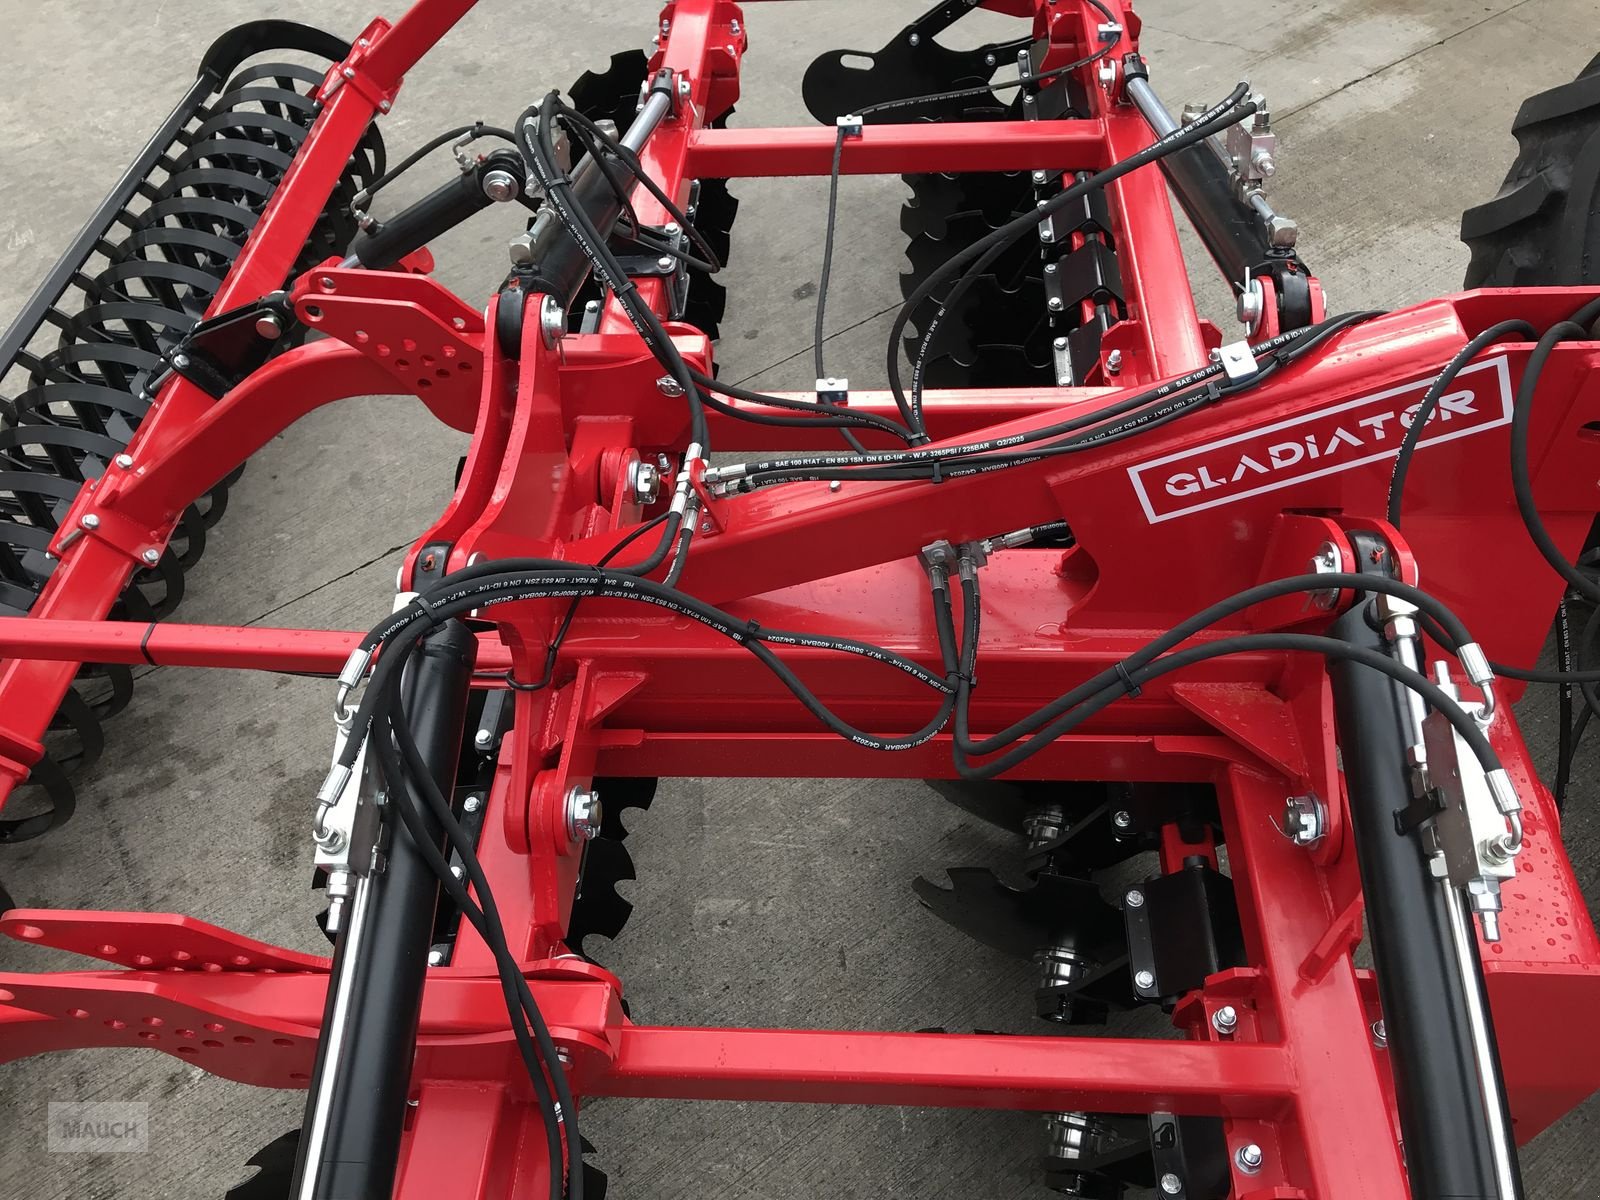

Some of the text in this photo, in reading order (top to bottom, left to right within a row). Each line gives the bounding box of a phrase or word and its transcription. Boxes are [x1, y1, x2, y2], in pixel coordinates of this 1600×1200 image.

[619, 296, 628, 309] R2A
[928, 320, 938, 332] SAE
[920, 342, 928, 357] R2AT
[1257, 342, 1272, 354] 1SN
[1274, 335, 1285, 345] DN
[916, 360, 922, 369] EN
[1158, 386, 1169, 395] HB
[1175, 377, 1192, 388] SAE
[1193, 371, 1205, 380] 100
[1174, 400, 1186, 408] 100
[1154, 405, 1173, 417] R2AT
[1124, 421, 1136, 429] 853
[1138, 416, 1148, 426] EN
[1108, 424, 1122, 436] 2SN
[930, 449, 957, 457] 3265PSI
[962, 443, 990, 453] 225BAR
[996, 435, 1025, 446] Q2/2025
[1164, 389, 1480, 497] GLADIATOR
[950, 468, 976, 477] Q4/2024
[981, 463, 1008, 472] 400BAR
[447, 590, 466, 600] W.P.
[519, 592, 546, 600] 400BAR
[641, 595, 655, 603] 2SN
[484, 595, 514, 606] Q4/2024
[655, 598, 667, 606] 853
[380, 618, 409, 640] 400BAR
[732, 632, 743, 641] HB
[768, 635, 795, 644] Q4/2024
[801, 639, 830, 648] 400BAR
[835, 644, 864, 654] 5800PSI
[866, 649, 882, 658] W.P.
[916, 673, 928, 681] DN
[852, 735, 880, 748] Q4/2024
